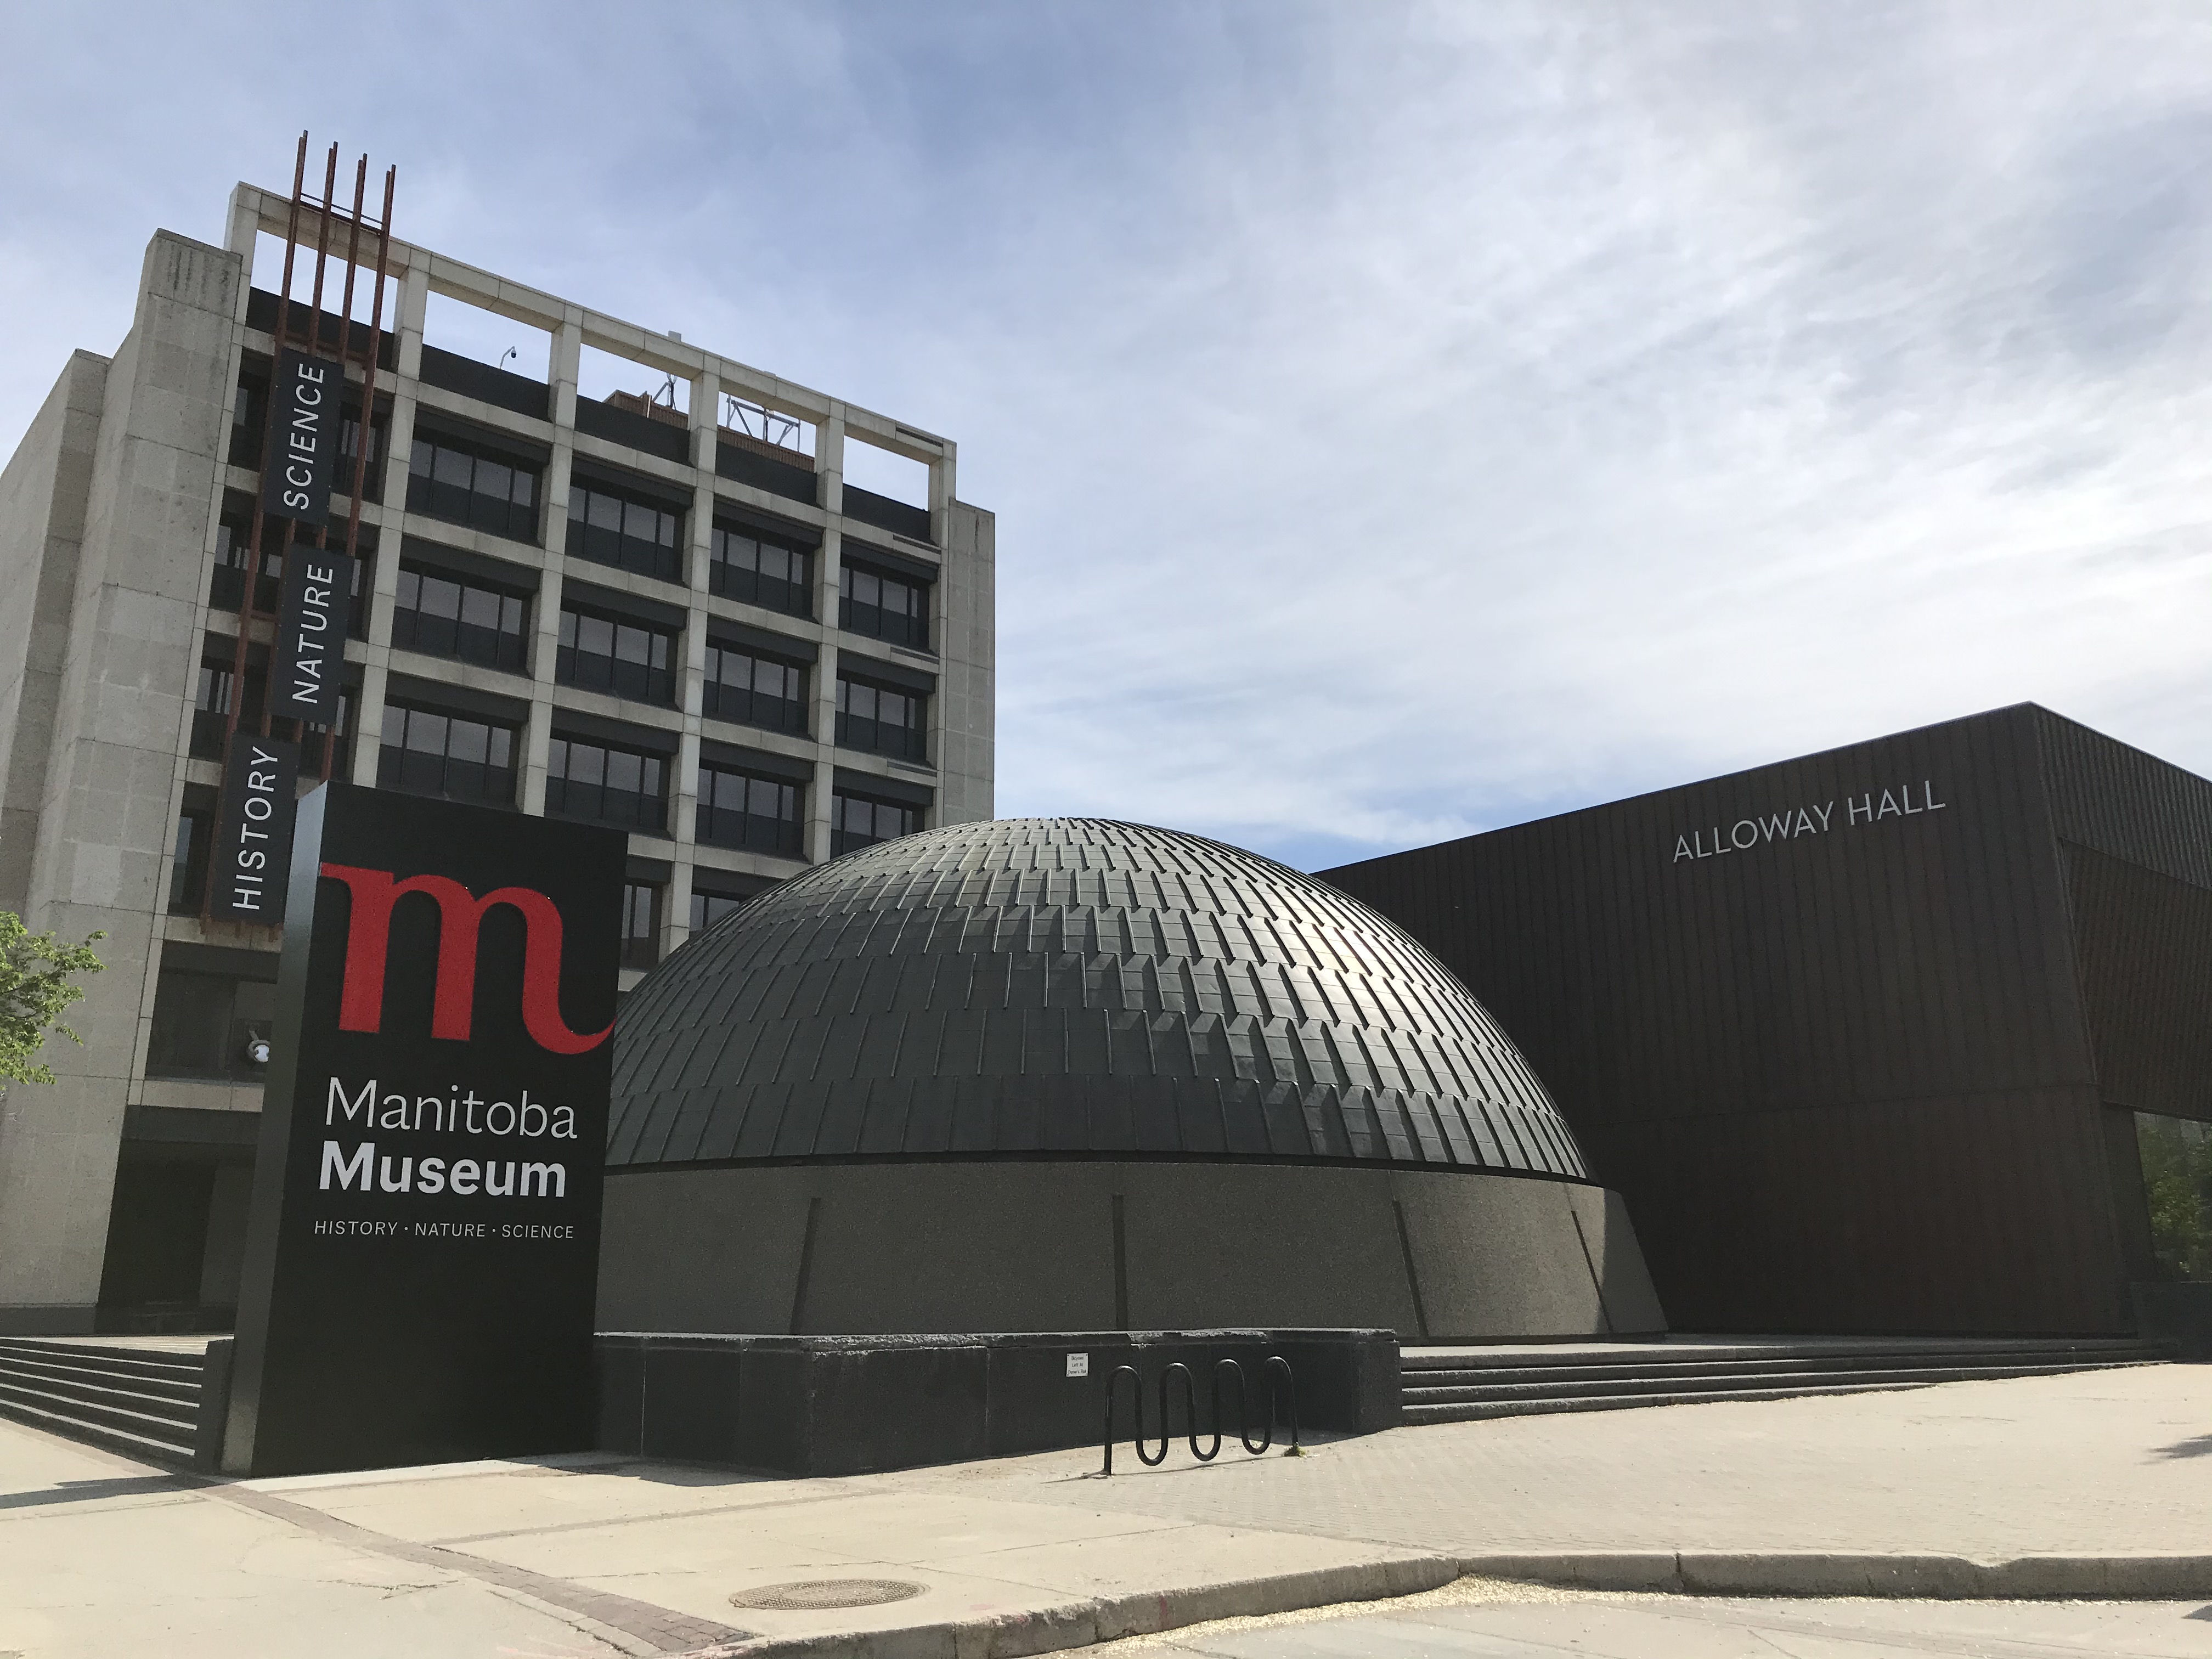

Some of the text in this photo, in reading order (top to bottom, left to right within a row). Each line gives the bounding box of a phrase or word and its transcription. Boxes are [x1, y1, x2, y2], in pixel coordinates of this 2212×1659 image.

[283, 363, 324, 510] SCIENCE
[292, 564, 333, 704] NATURE
[232, 746, 278, 910] HISTORY
[1673, 780, 1946, 863] ALLOWAY HALL
[325, 1076, 578, 1139] Manitoba
[319, 1140, 566, 1198] Museum
[314, 1220, 574, 1239] HISTORY NATURE SCIENCE
